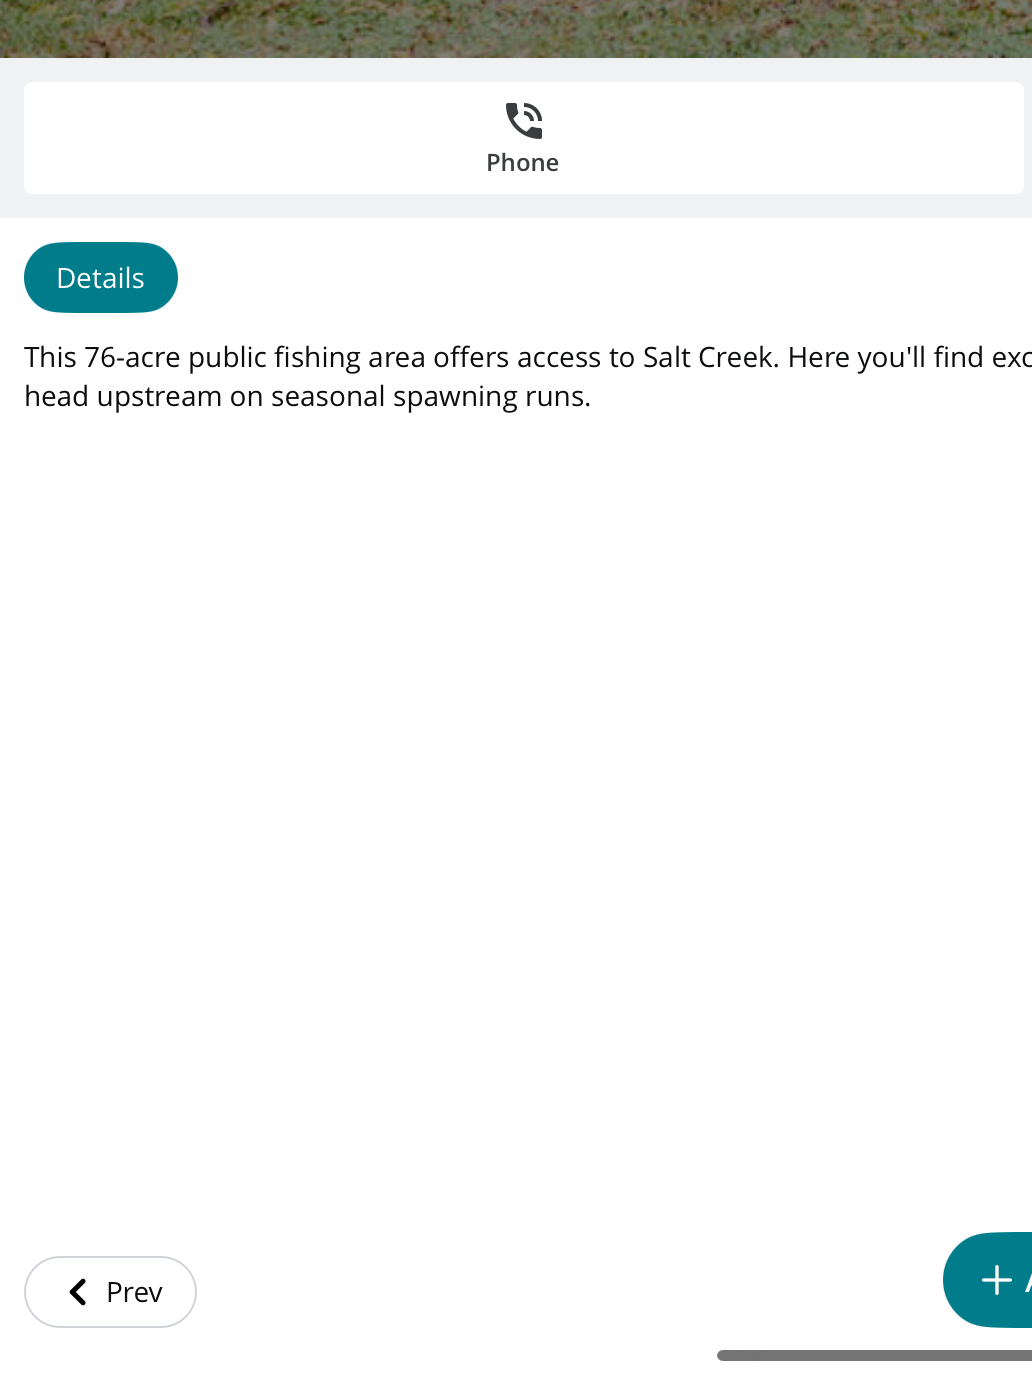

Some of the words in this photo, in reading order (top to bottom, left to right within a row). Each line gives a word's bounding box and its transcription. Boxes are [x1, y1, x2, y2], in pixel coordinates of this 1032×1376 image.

[487, 152, 559, 172] Phone
[58, 266, 145, 289] Details
[23, 344, 77, 368] This
[84, 346, 180, 368] 76-acre
[189, 344, 267, 375] public
[273, 344, 361, 375] fishing
[368, 351, 425, 368] area
[433, 344, 509, 368] offers
[517, 351, 601, 368] access
[608, 347, 635, 368] to
[643, 344, 692, 368] Salt
[699, 344, 779, 369] Creek.
[789, 346, 850, 368] Here
[856, 344, 925, 375] you'll
[933, 344, 983, 368] find
[25, 383, 88, 407] head
[97, 386, 222, 414] upstream
[230, 390, 263, 407] on
[271, 383, 384, 407] seasonal
[393, 384, 518, 414] spawning
[526, 390, 591, 408] runs.
[107, 1281, 164, 1303] Prev
